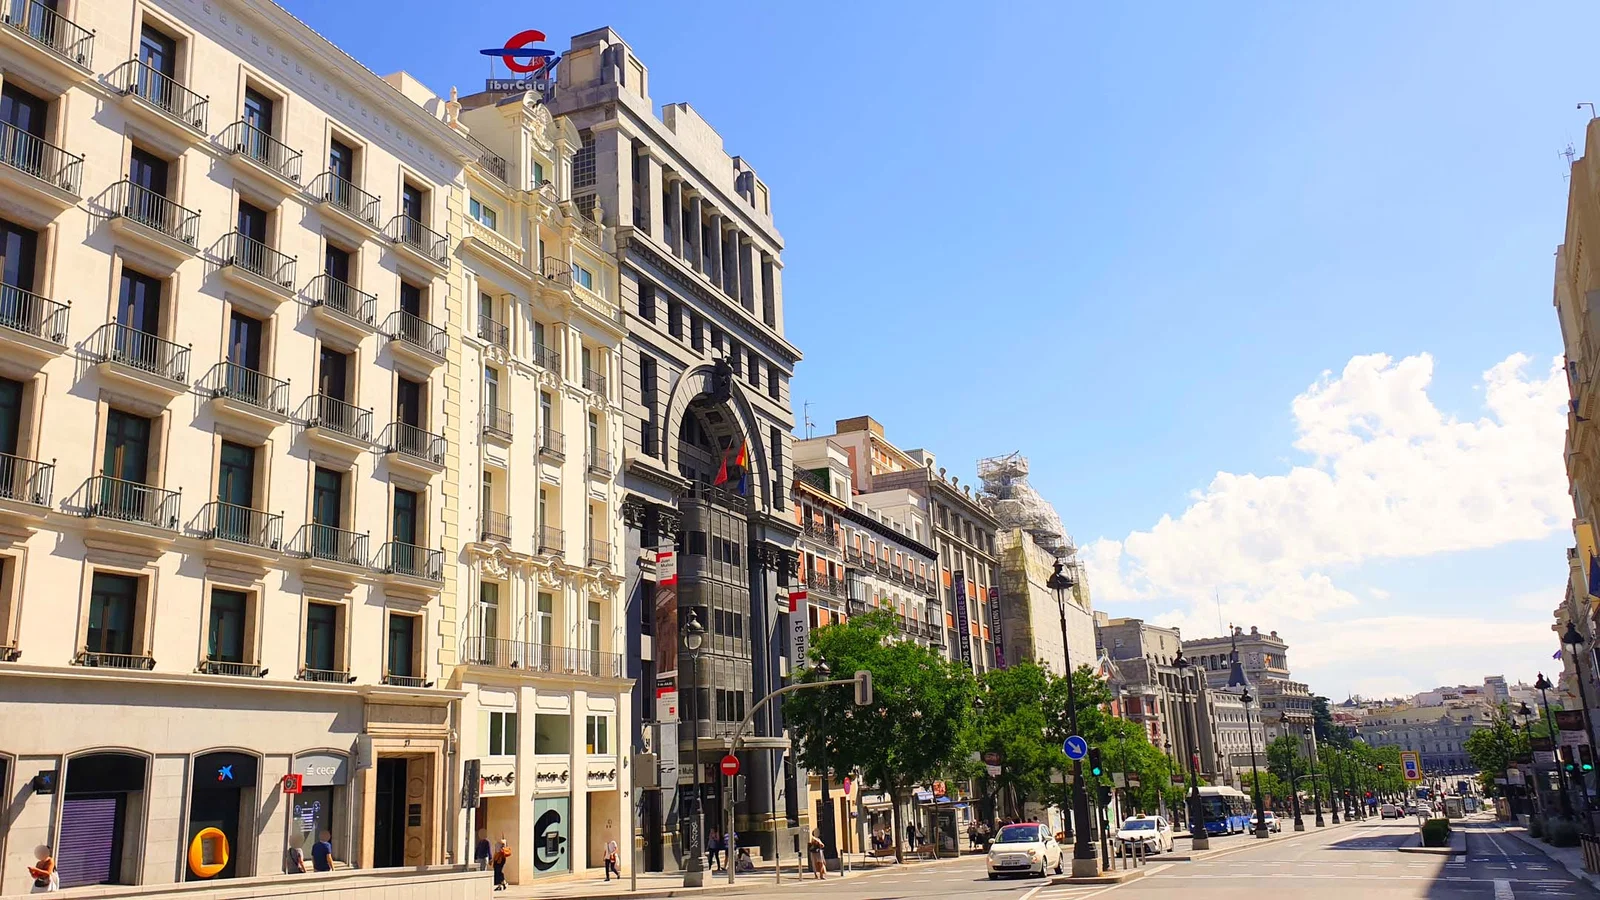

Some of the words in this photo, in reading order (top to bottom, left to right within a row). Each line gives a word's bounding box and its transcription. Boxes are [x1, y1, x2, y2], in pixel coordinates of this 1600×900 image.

[958, 595, 968, 635] MUJERES
[794, 620, 804, 633] 31
[961, 635, 969, 649] SER
[794, 635, 805, 671] Alcalá
[316, 766, 336, 775] ceca
